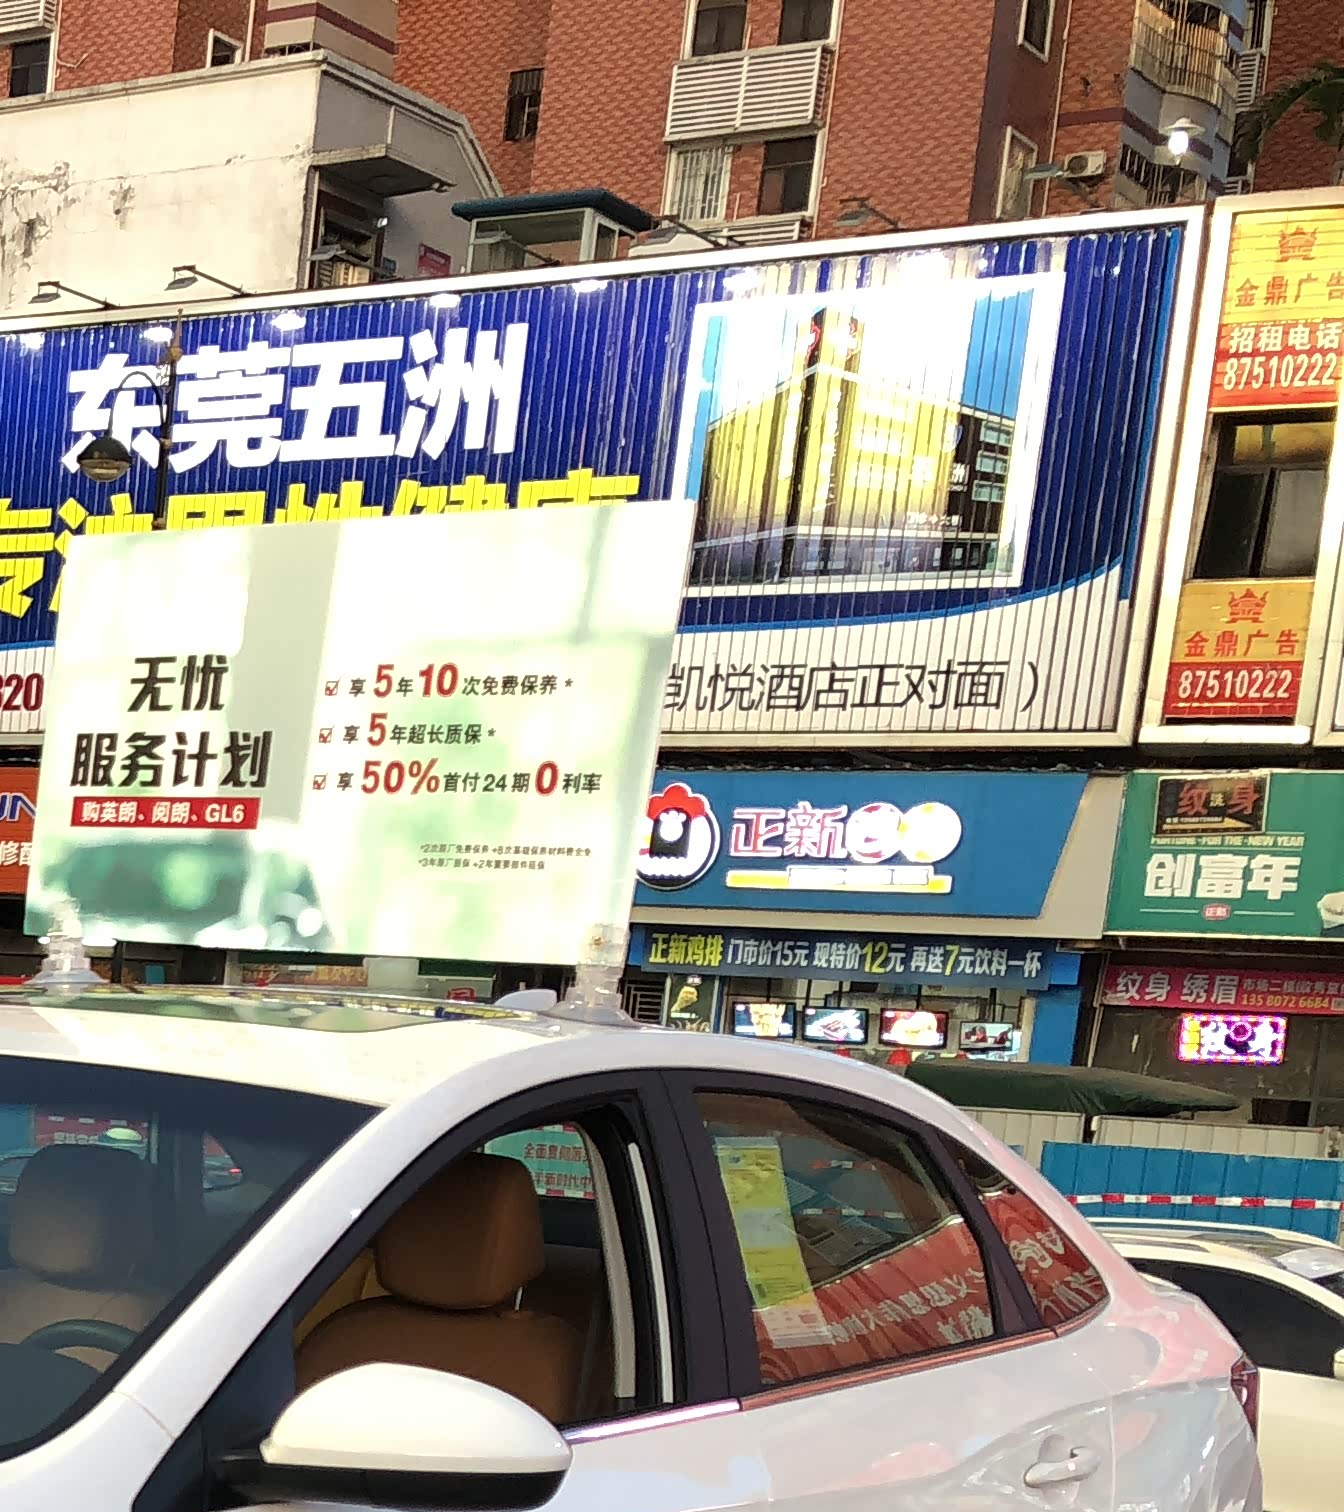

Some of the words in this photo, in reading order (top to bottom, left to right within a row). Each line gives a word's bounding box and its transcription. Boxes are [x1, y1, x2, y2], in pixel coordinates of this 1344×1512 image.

[1235, 271, 1344, 308] 金鼎广告
[1229, 321, 1343, 354] 招租电话
[1223, 352, 1338, 391] 87510222
[61, 322, 530, 476] 东莞五洲
[1184, 628, 1300, 659] 金鼎广告
[127, 654, 230, 713] 无忧
[1178, 669, 1293, 699] 87510222
[70, 730, 273, 788] 服务计划
[1144, 854, 1302, 901] 创富年
[649, 933, 724, 966] 正新鸡排
[727, 938, 809, 968] 门市价15元
[813, 941, 906, 974] 现特价12元
[910, 944, 1042, 978] 再送7元饮料一杯
[1116, 970, 1172, 1002] 纹身
[1180, 974, 1240, 1006] 绣眉
[1241, 993, 1263, 1006] 135
[1267, 995, 1297, 1008] 8072
